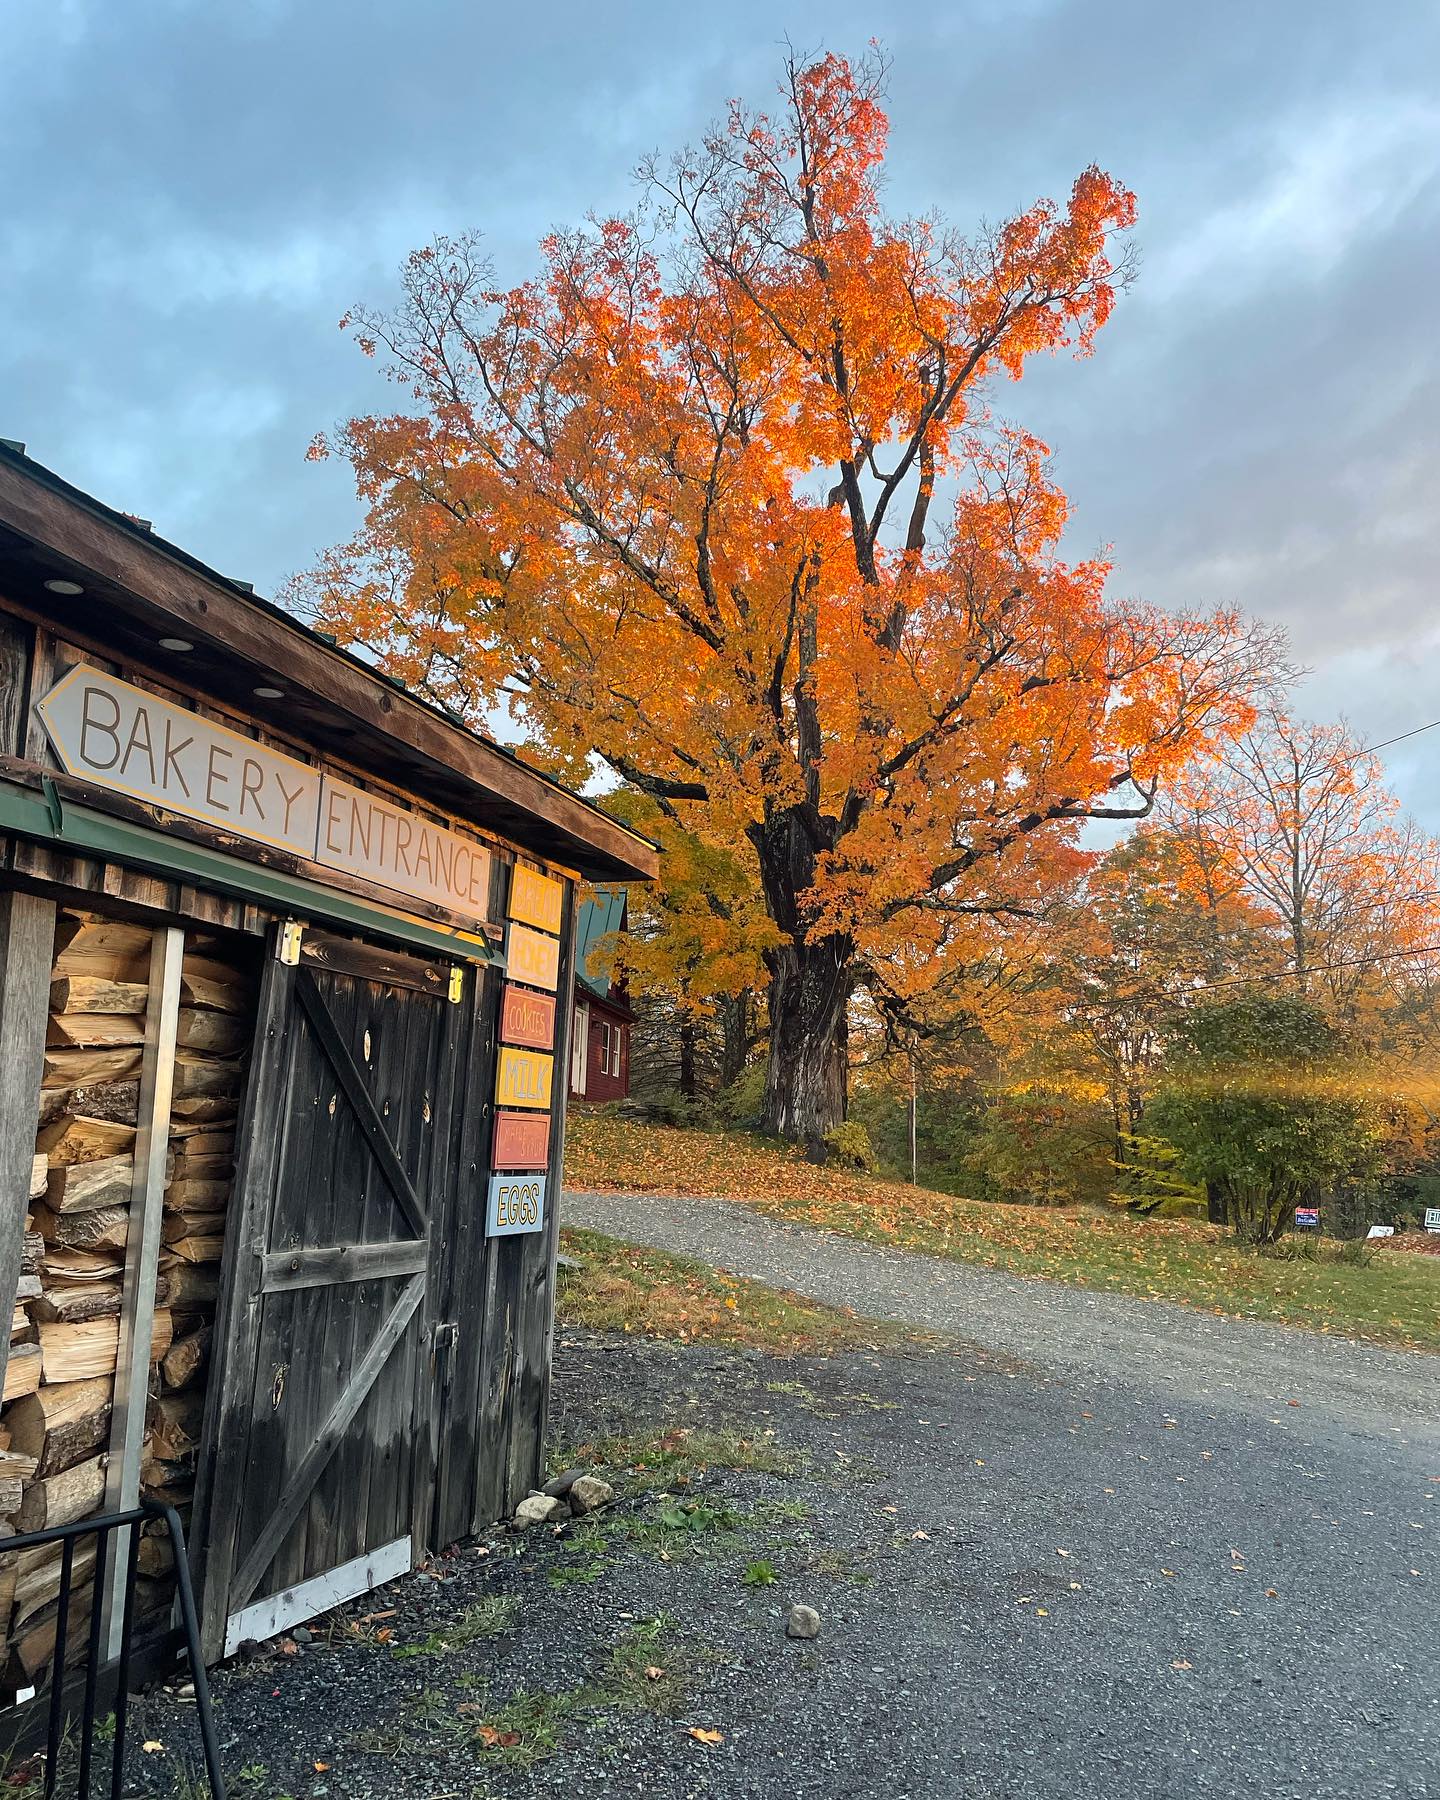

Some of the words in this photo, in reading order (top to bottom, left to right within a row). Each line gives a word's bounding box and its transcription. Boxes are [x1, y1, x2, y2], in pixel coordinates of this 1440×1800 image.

[79, 687, 304, 834] BAKERY
[326, 791, 481, 905] ENTRANCE
[515, 872, 557, 923] BREAD
[510, 1003, 545, 1036] COOKIES
[505, 1057, 549, 1099] MILK
[521, 1141, 543, 1157] SYRUP
[497, 1183, 539, 1226] EGGS
